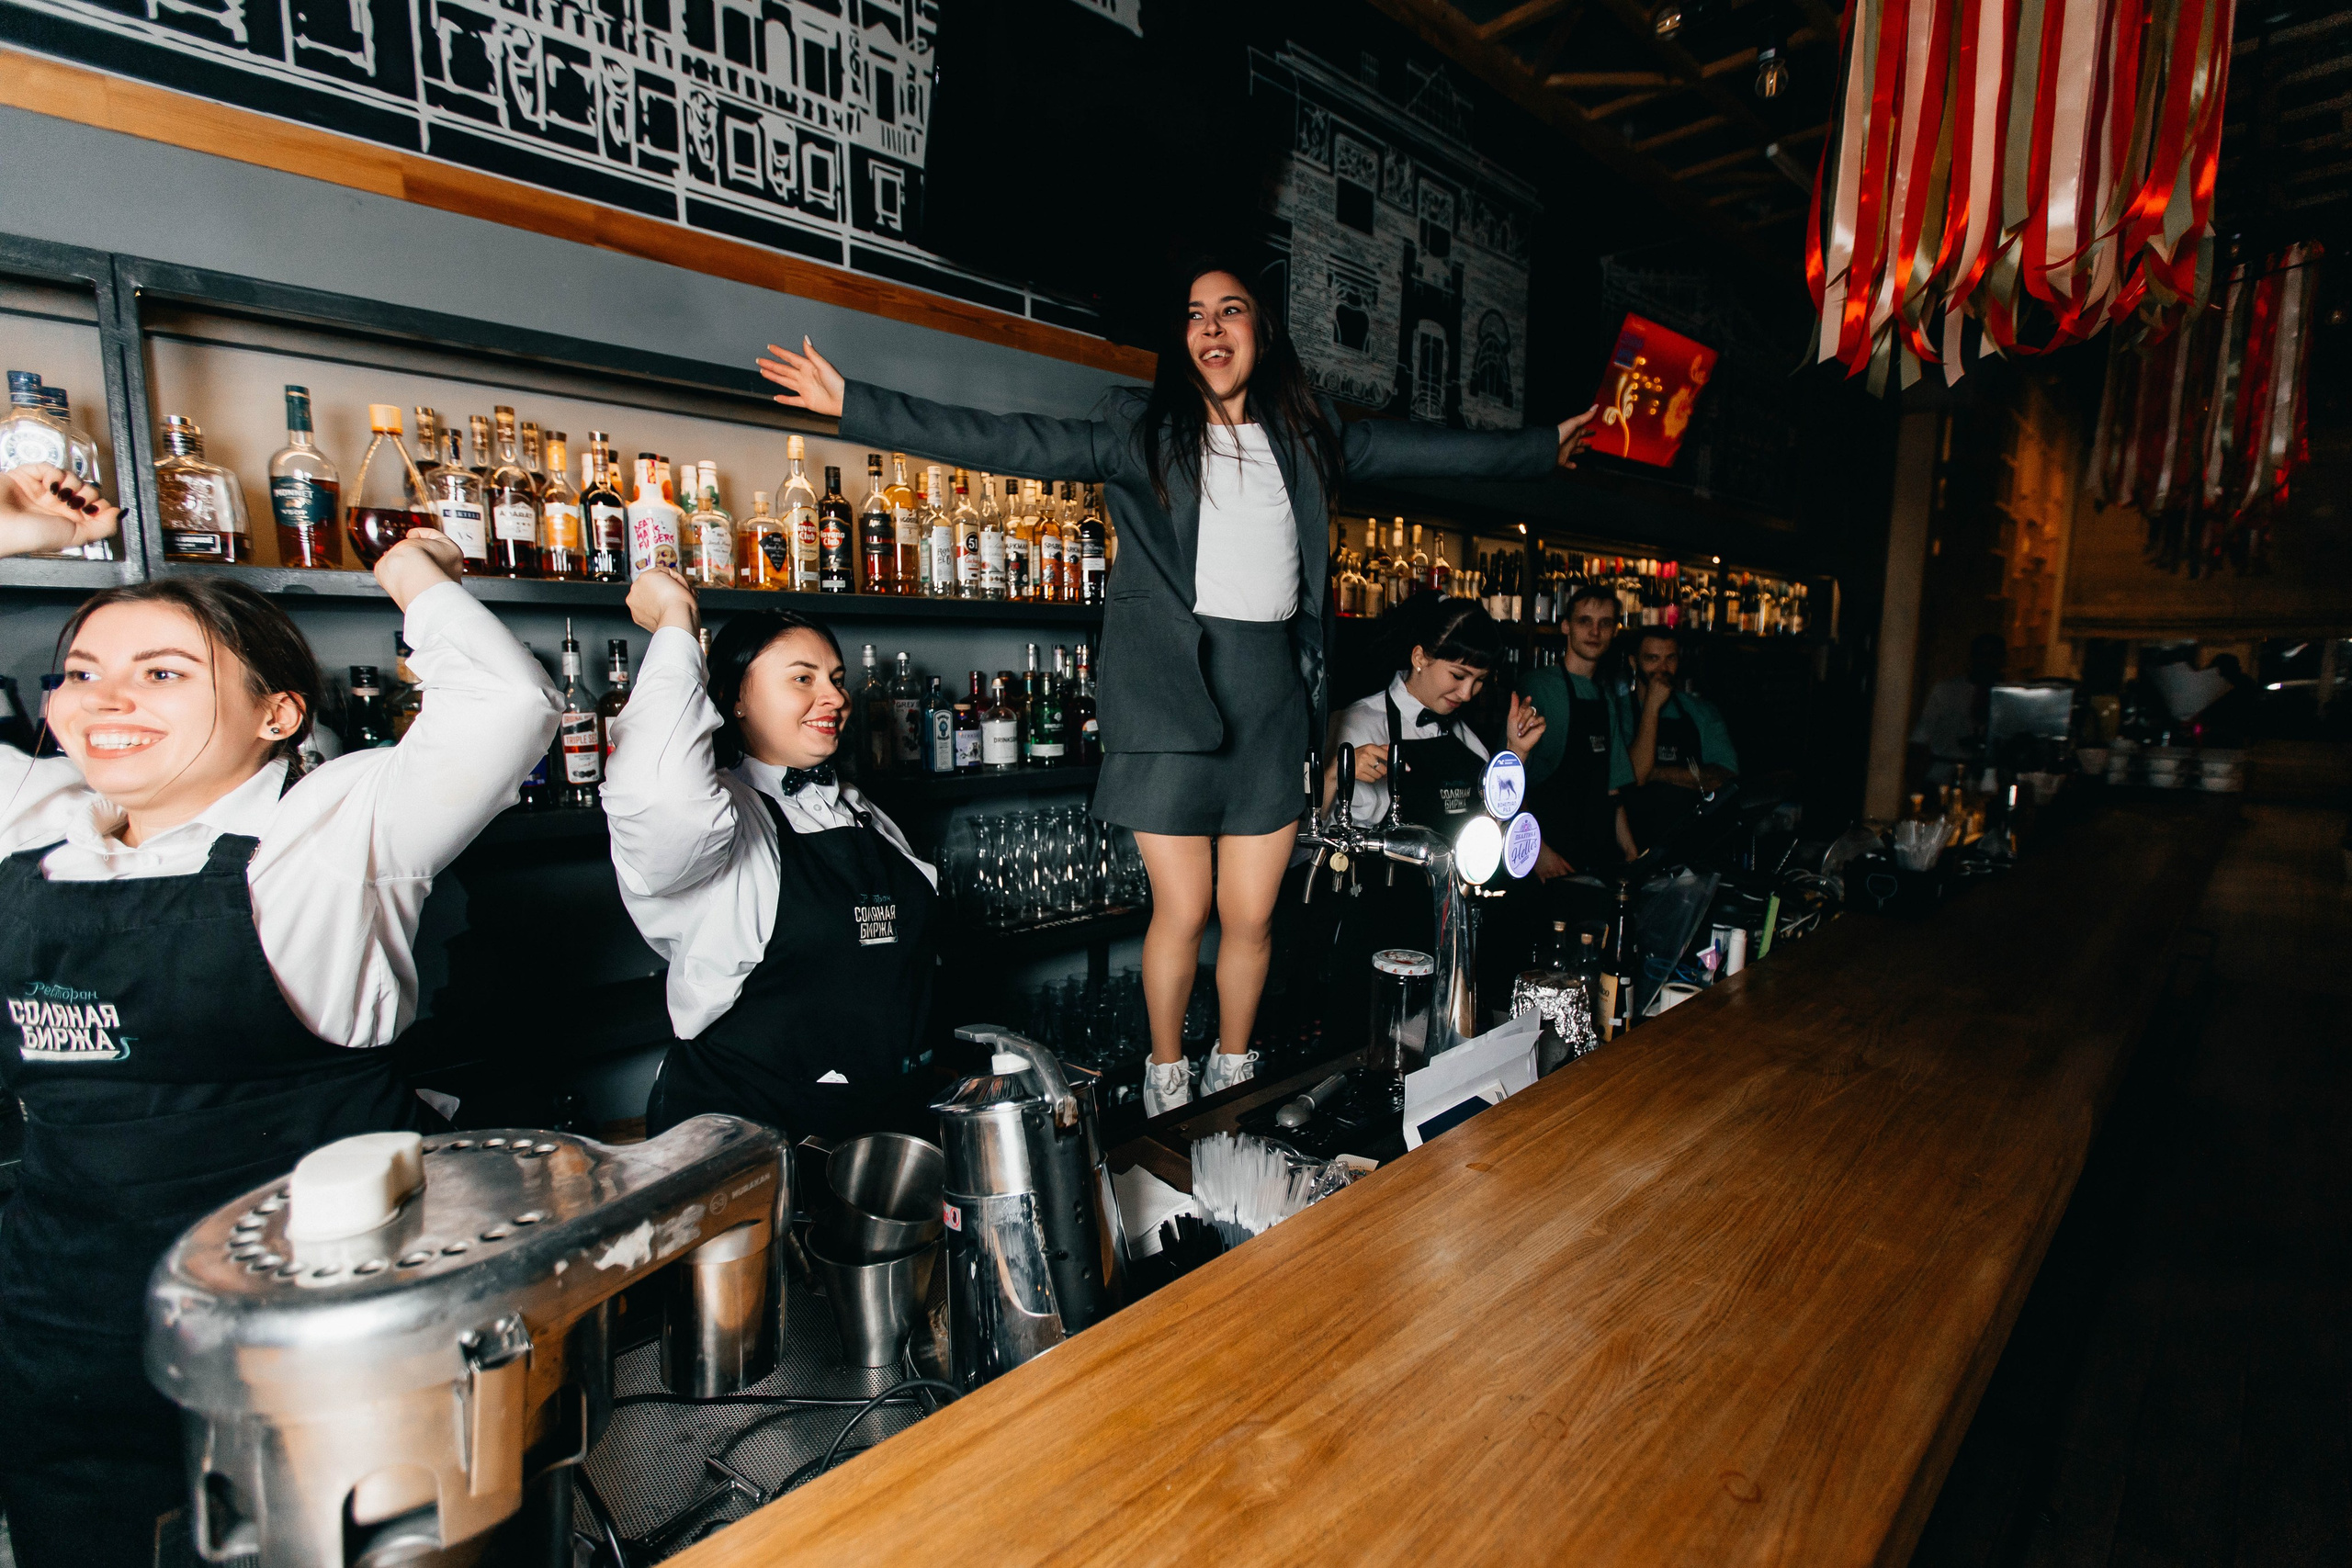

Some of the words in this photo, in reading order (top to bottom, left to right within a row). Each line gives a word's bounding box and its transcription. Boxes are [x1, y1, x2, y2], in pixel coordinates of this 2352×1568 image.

[273, 489, 313, 498] MONNET
[968, 538, 978, 549] 51
[566, 735, 587, 745] TRIPLE
[854, 905, 896, 922] СОЛЯНАЯ
[860, 921, 894, 939] БИРЖА
[7, 998, 120, 1028] СОЛЯНАЯ
[21, 1025, 116, 1051] БИРЖА
